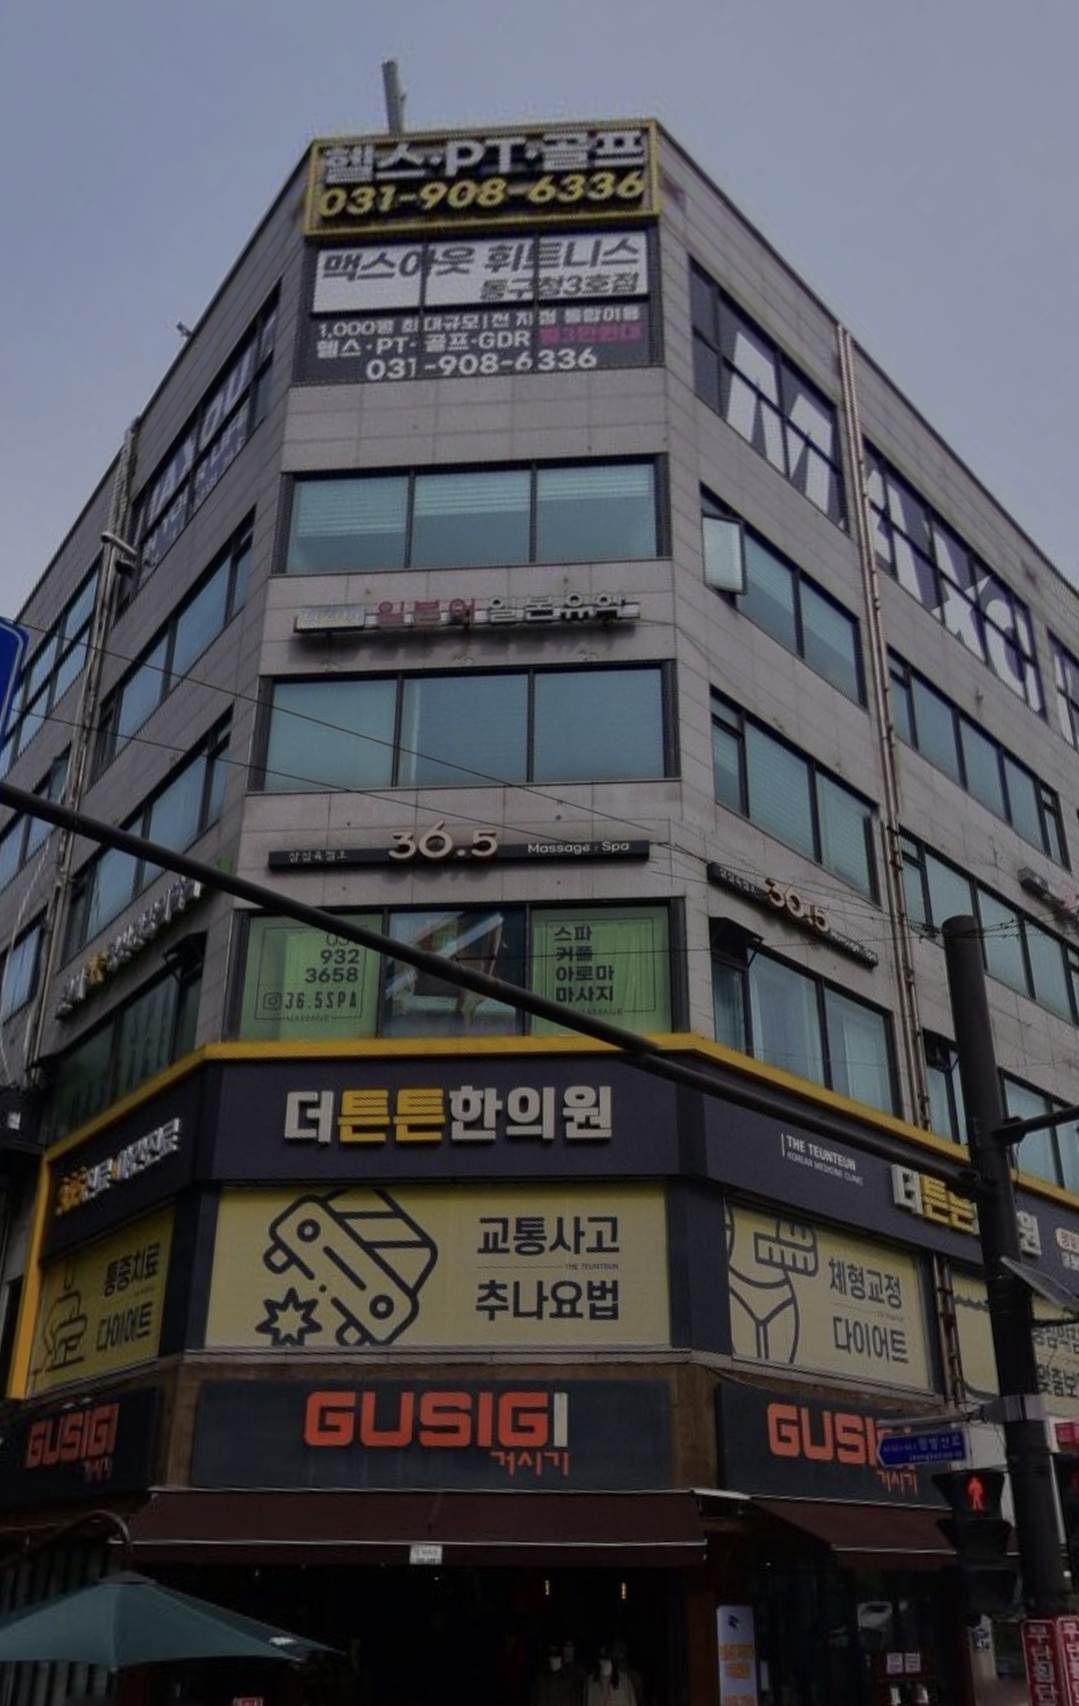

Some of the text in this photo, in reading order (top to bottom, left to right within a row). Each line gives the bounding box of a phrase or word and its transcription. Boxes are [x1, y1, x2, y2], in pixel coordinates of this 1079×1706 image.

[318, 170, 645, 217] 031-908-6336
[323, 238, 640, 281] 맥스아웃 휘트니스
[366, 348, 598, 380] 031-908-6336
[388, 819, 498, 860] 36.5
[527, 842, 591, 856] Massage
[602, 840, 631, 853] Spa
[554, 926, 592, 941] 스파
[556, 946, 593, 961] 커플
[305, 967, 359, 983] 3658
[321, 949, 359, 964] 932
[555, 965, 614, 981] 아로마
[555, 985, 613, 1002] 마사지
[284, 1085, 613, 1145] 더튼튼한의원
[786, 1135, 805, 1153] THE
[477, 1216, 619, 1256] 교통사고
[104, 1240, 160, 1297] 통증치료
[828, 1257, 902, 1310] 체형교정
[476, 1280, 619, 1321] 추나요법
[96, 1301, 153, 1352] 다이어트
[832, 1316, 909, 1365] 다이어트
[23, 1403, 120, 1469] GUSIGI
[303, 1391, 569, 1449] GUSIGI
[491, 1452, 570, 1477] 거시기
